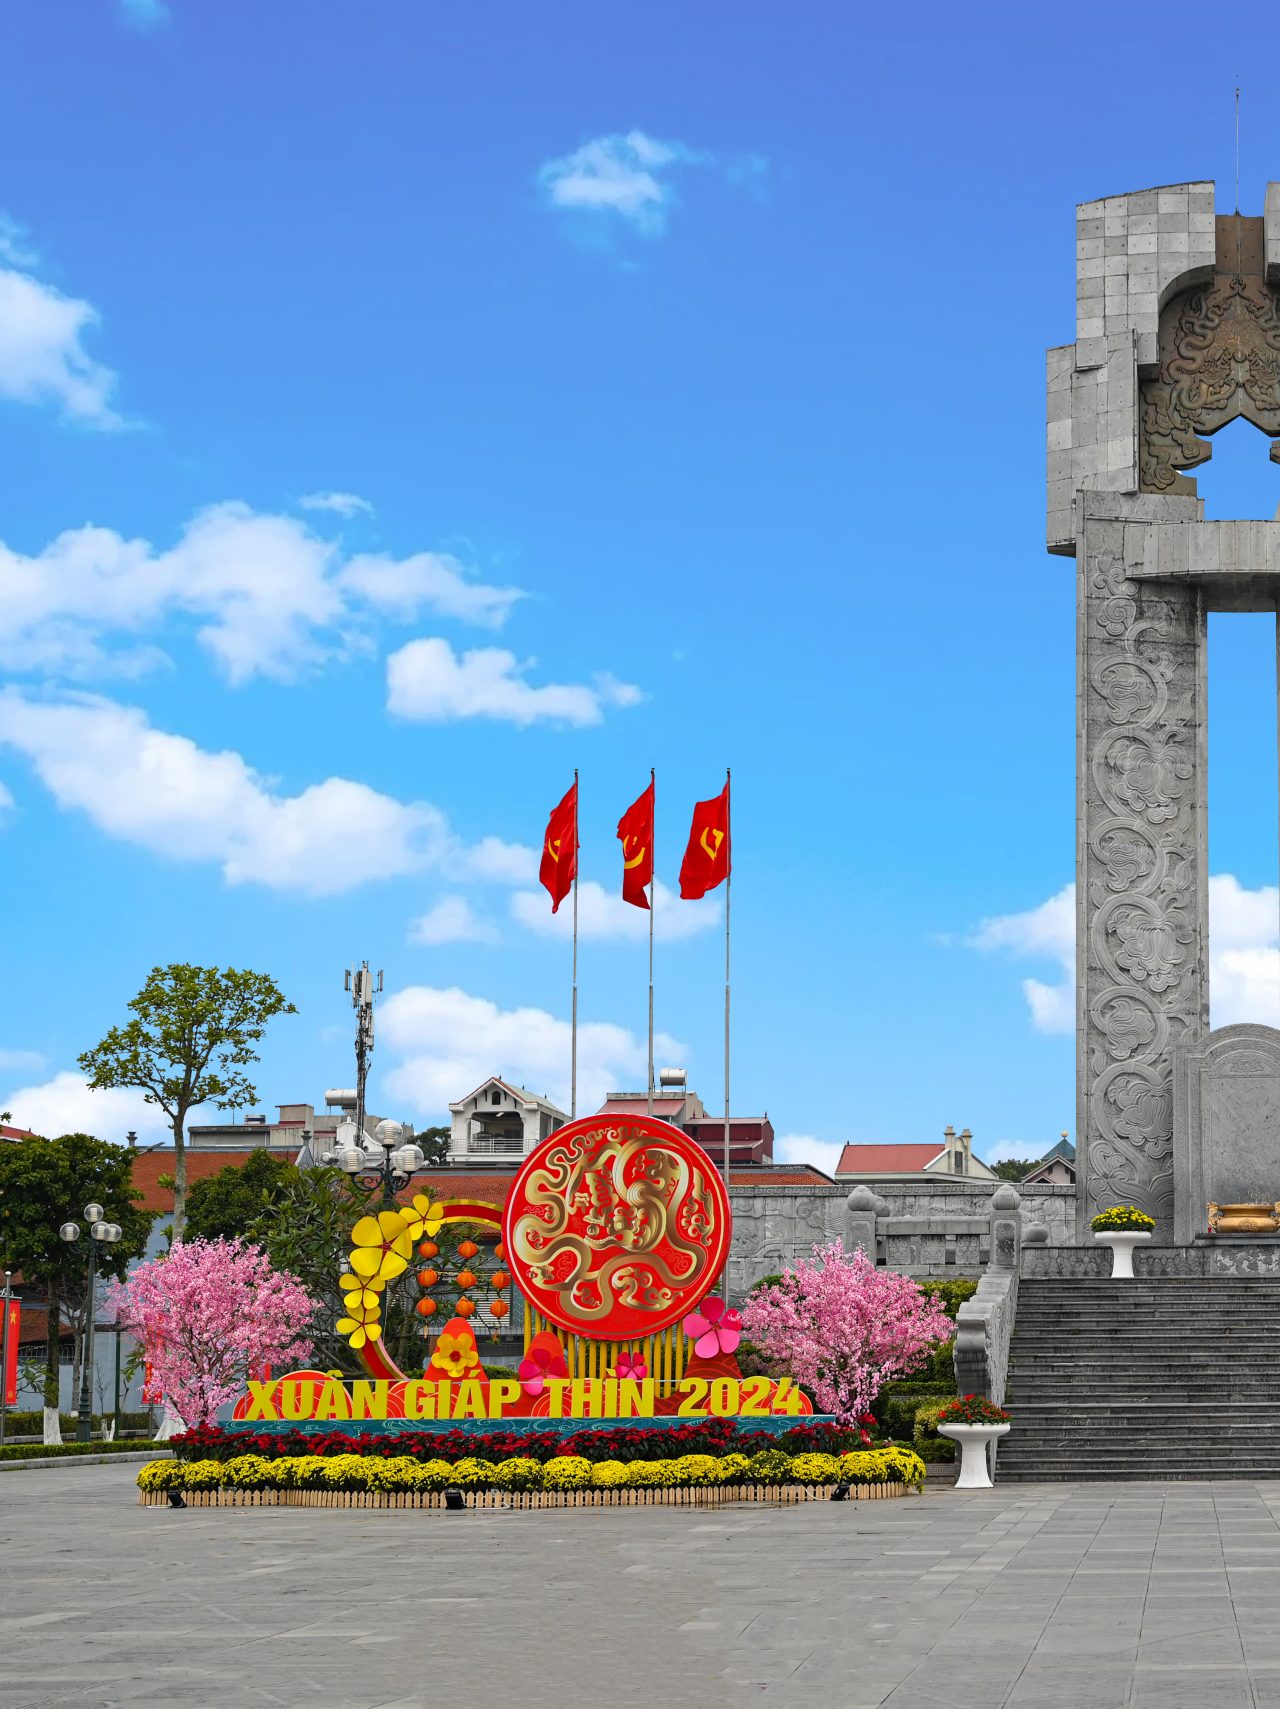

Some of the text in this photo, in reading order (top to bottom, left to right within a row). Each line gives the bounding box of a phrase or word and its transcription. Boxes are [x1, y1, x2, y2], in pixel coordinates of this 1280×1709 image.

[245, 1368, 804, 1421] XUÂN GIÁP THÌN 2024
